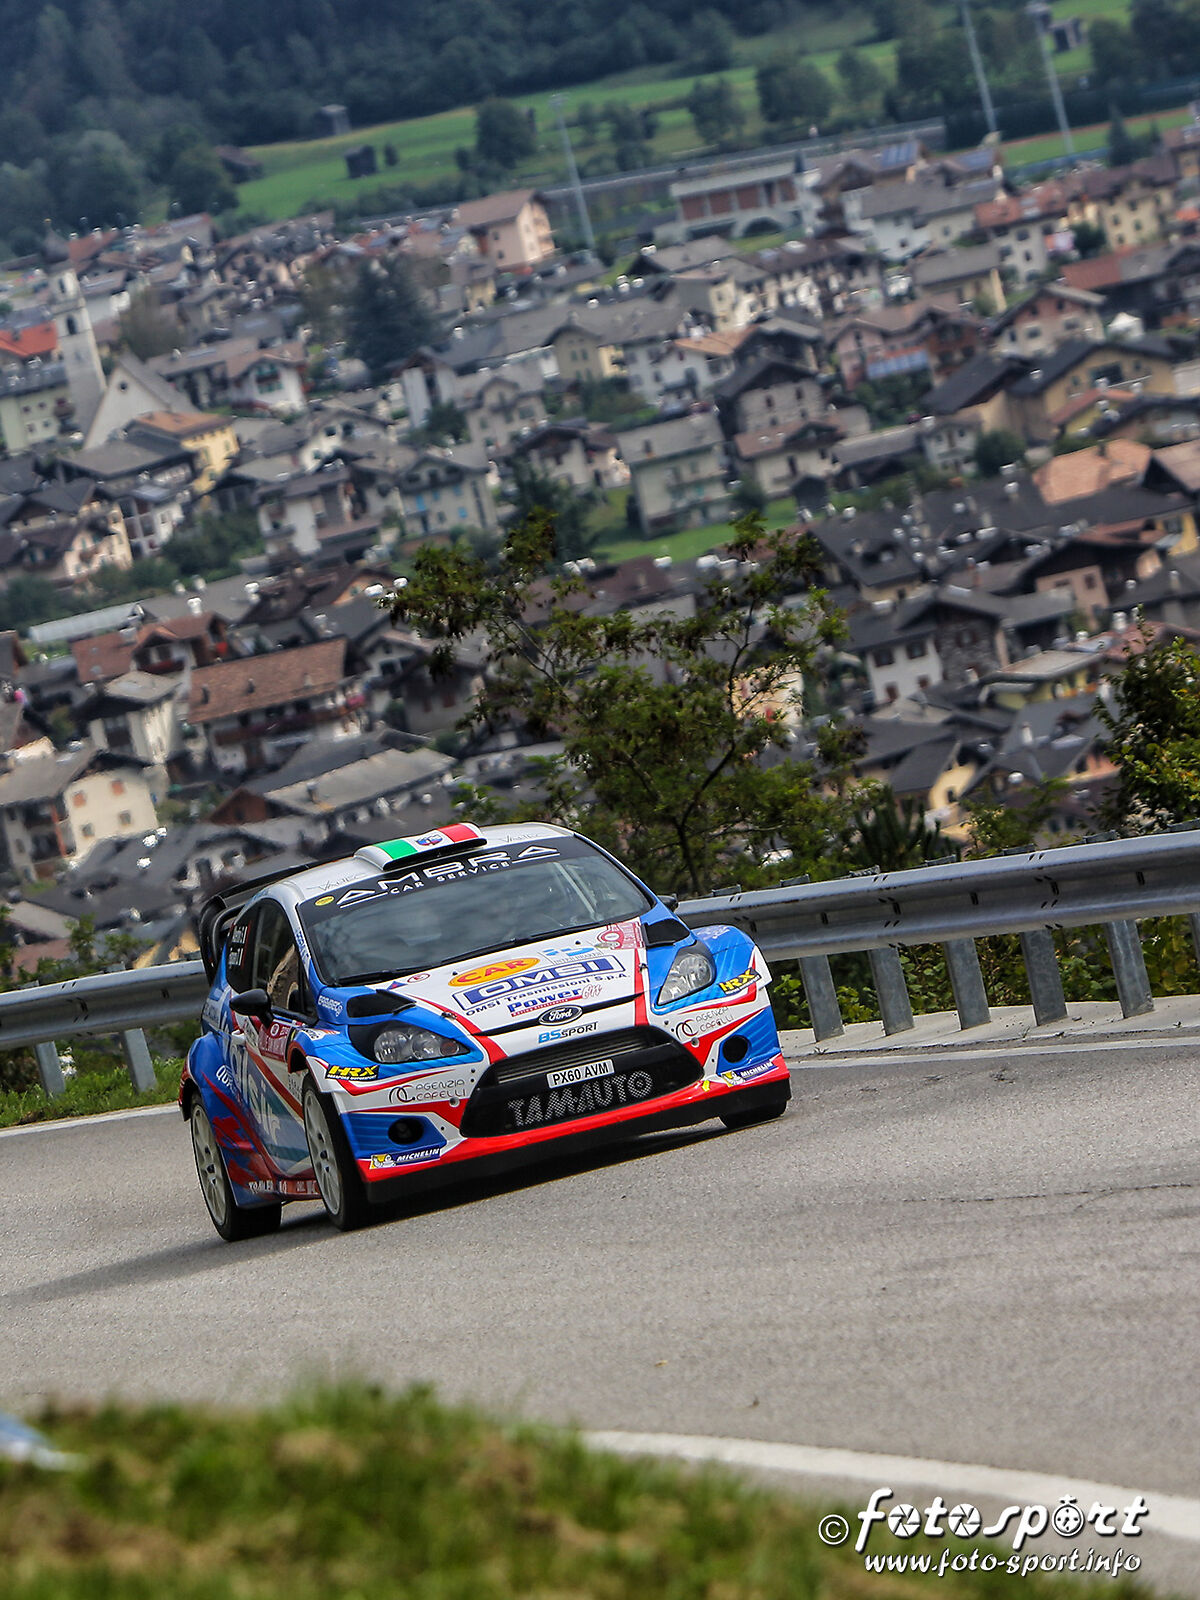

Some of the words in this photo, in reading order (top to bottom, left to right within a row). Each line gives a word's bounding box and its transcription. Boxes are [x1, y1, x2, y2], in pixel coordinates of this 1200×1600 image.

[337, 845, 560, 908] AMBRA
[391, 882, 424, 894] CAR
[437, 861, 510, 882] SERVICE
[456, 960, 529, 983] CAR
[478, 960, 600, 997] OMSI
[719, 969, 755, 991] HRX
[466, 1000, 502, 1016] OMSI
[502, 978, 590, 1002] Trasmissioni
[507, 988, 581, 1012] Power
[548, 1008, 573, 1021] Ford
[328, 1065, 378, 1077] HRX
[552, 1068, 582, 1086] PX60
[584, 1062, 609, 1078] AVM
[740, 1060, 774, 1078] MICHELIN
[396, 1148, 440, 1162] MICHELIN
